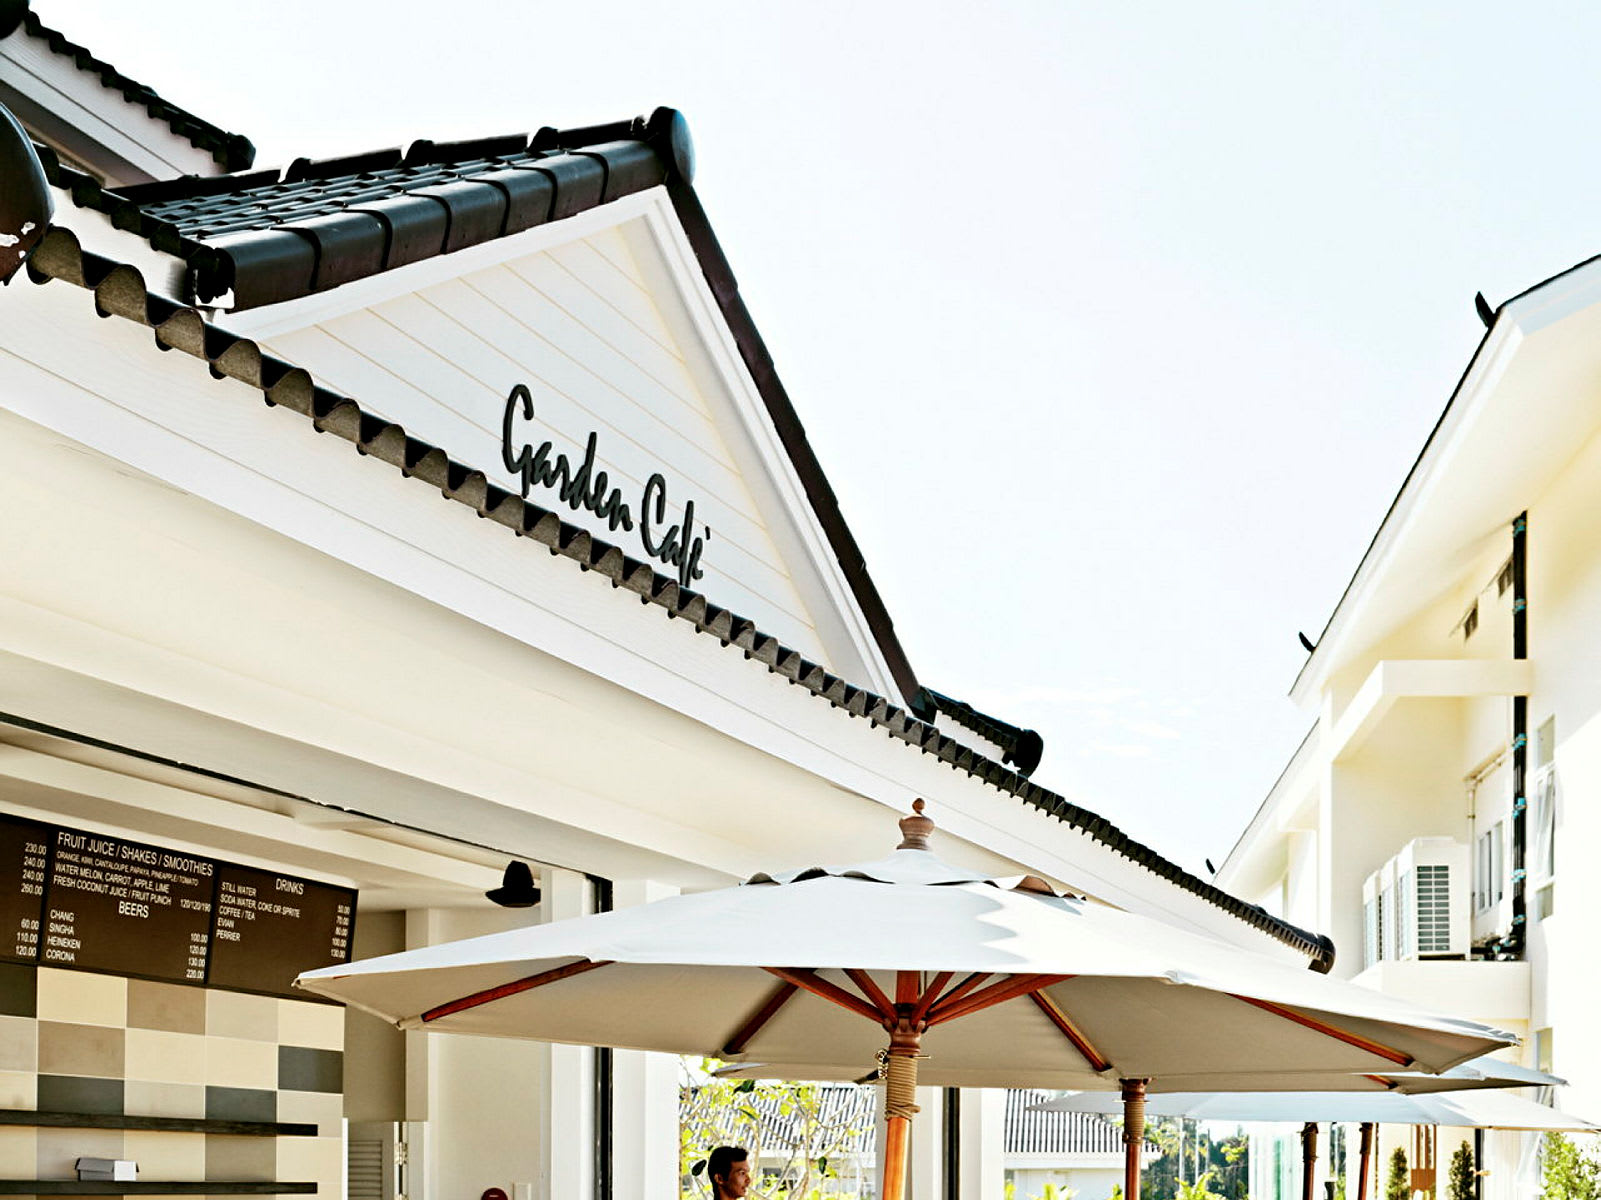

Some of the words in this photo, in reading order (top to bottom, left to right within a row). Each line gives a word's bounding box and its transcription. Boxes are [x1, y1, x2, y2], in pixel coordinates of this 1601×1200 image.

[502, 384, 633, 531] Garden
[25, 842, 47, 855] 230.00
[58, 832, 87, 849] FRUIT
[88, 839, 115, 856] JUICE
[121, 845, 157, 865] SHAKES
[163, 854, 213, 876] SMOOTHIES
[23, 856, 46, 869] 240.00
[22, 869, 44, 882] 240.00
[54, 862, 79, 876] WATER
[155, 883, 170, 894] LIME
[21, 883, 43, 896] 260.00
[53, 875, 76, 888] FRESH
[76, 879, 109, 894] COCONUT
[109, 886, 128, 898] JUICE
[131, 890, 150, 901] FRUIT
[150, 893, 172, 905] PUNCH
[221, 881, 236, 893] STILL
[237, 885, 257, 897] WATER
[275, 878, 304, 895] DRINKS
[118, 900, 149, 919] BEERS
[220, 893, 236, 904] SODA
[257, 901, 273, 913] COKE
[273, 904, 282, 914] OR
[282, 906, 300, 918] SPRITE
[50, 909, 75, 923] CHANG
[219, 905, 241, 918] COFFEE
[245, 910, 256, 921] TEA
[48, 922, 75, 936] SINGHA
[215, 929, 241, 942] PERRIER
[46, 936, 81, 950] HEINEKEN
[15, 945, 37, 957] 120.00
[45, 949, 76, 962] CORONA
